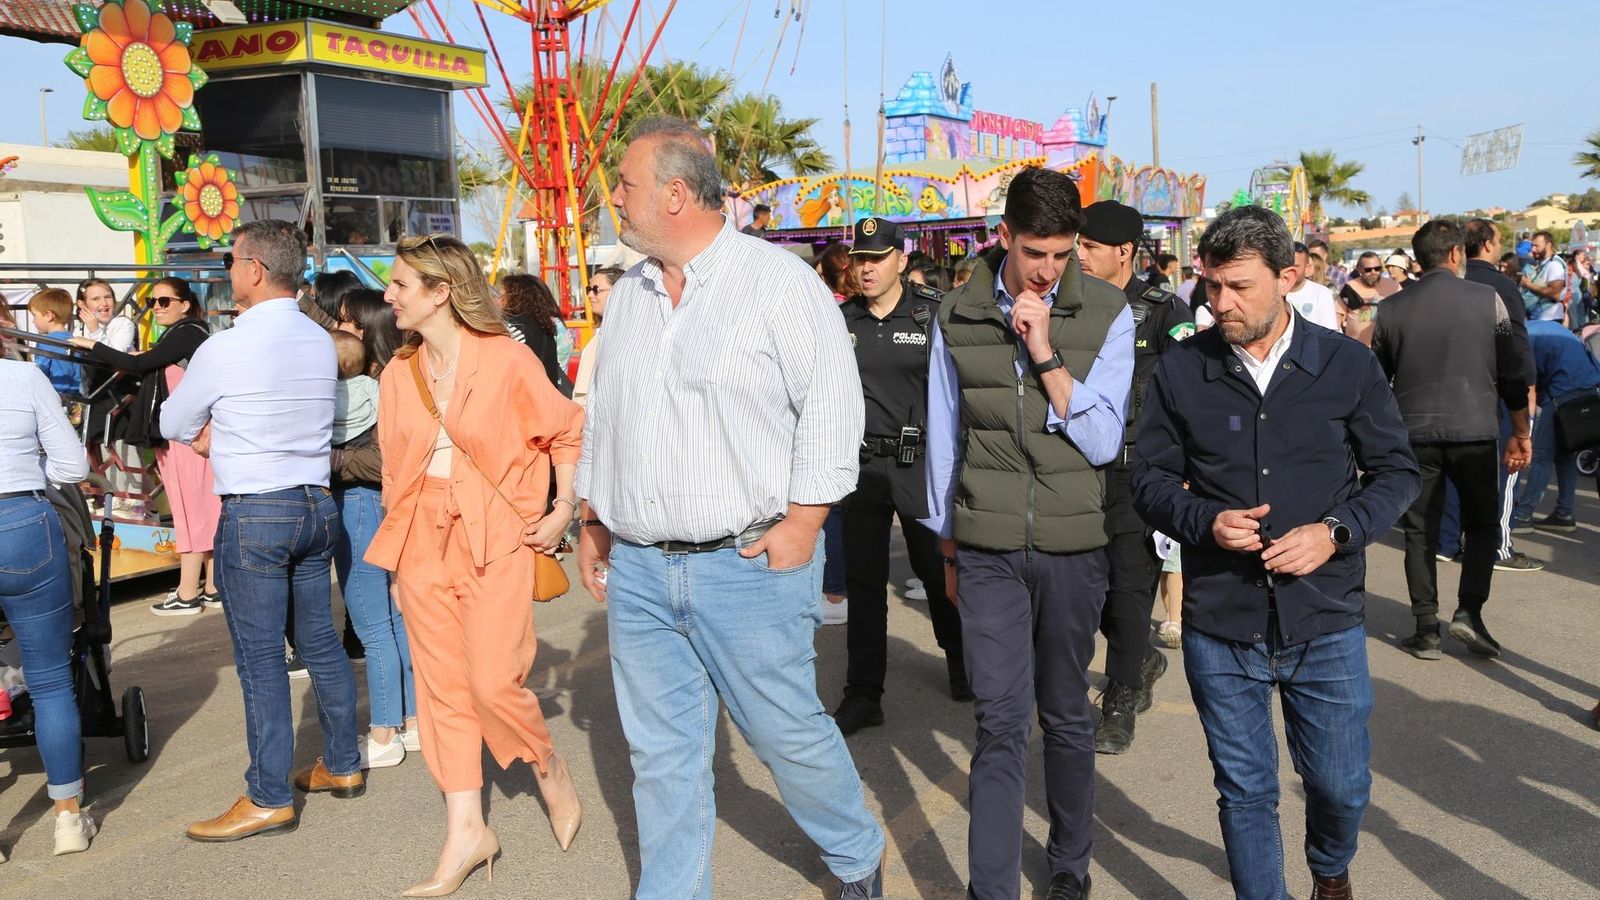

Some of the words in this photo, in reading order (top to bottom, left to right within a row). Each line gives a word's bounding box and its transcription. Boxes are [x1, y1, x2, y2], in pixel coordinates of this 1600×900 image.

[190, 29, 300, 62] ANO
[326, 31, 472, 74] TAQUILLA
[970, 111, 1012, 137] DISNEY
[893, 332, 926, 341] POLICIA
